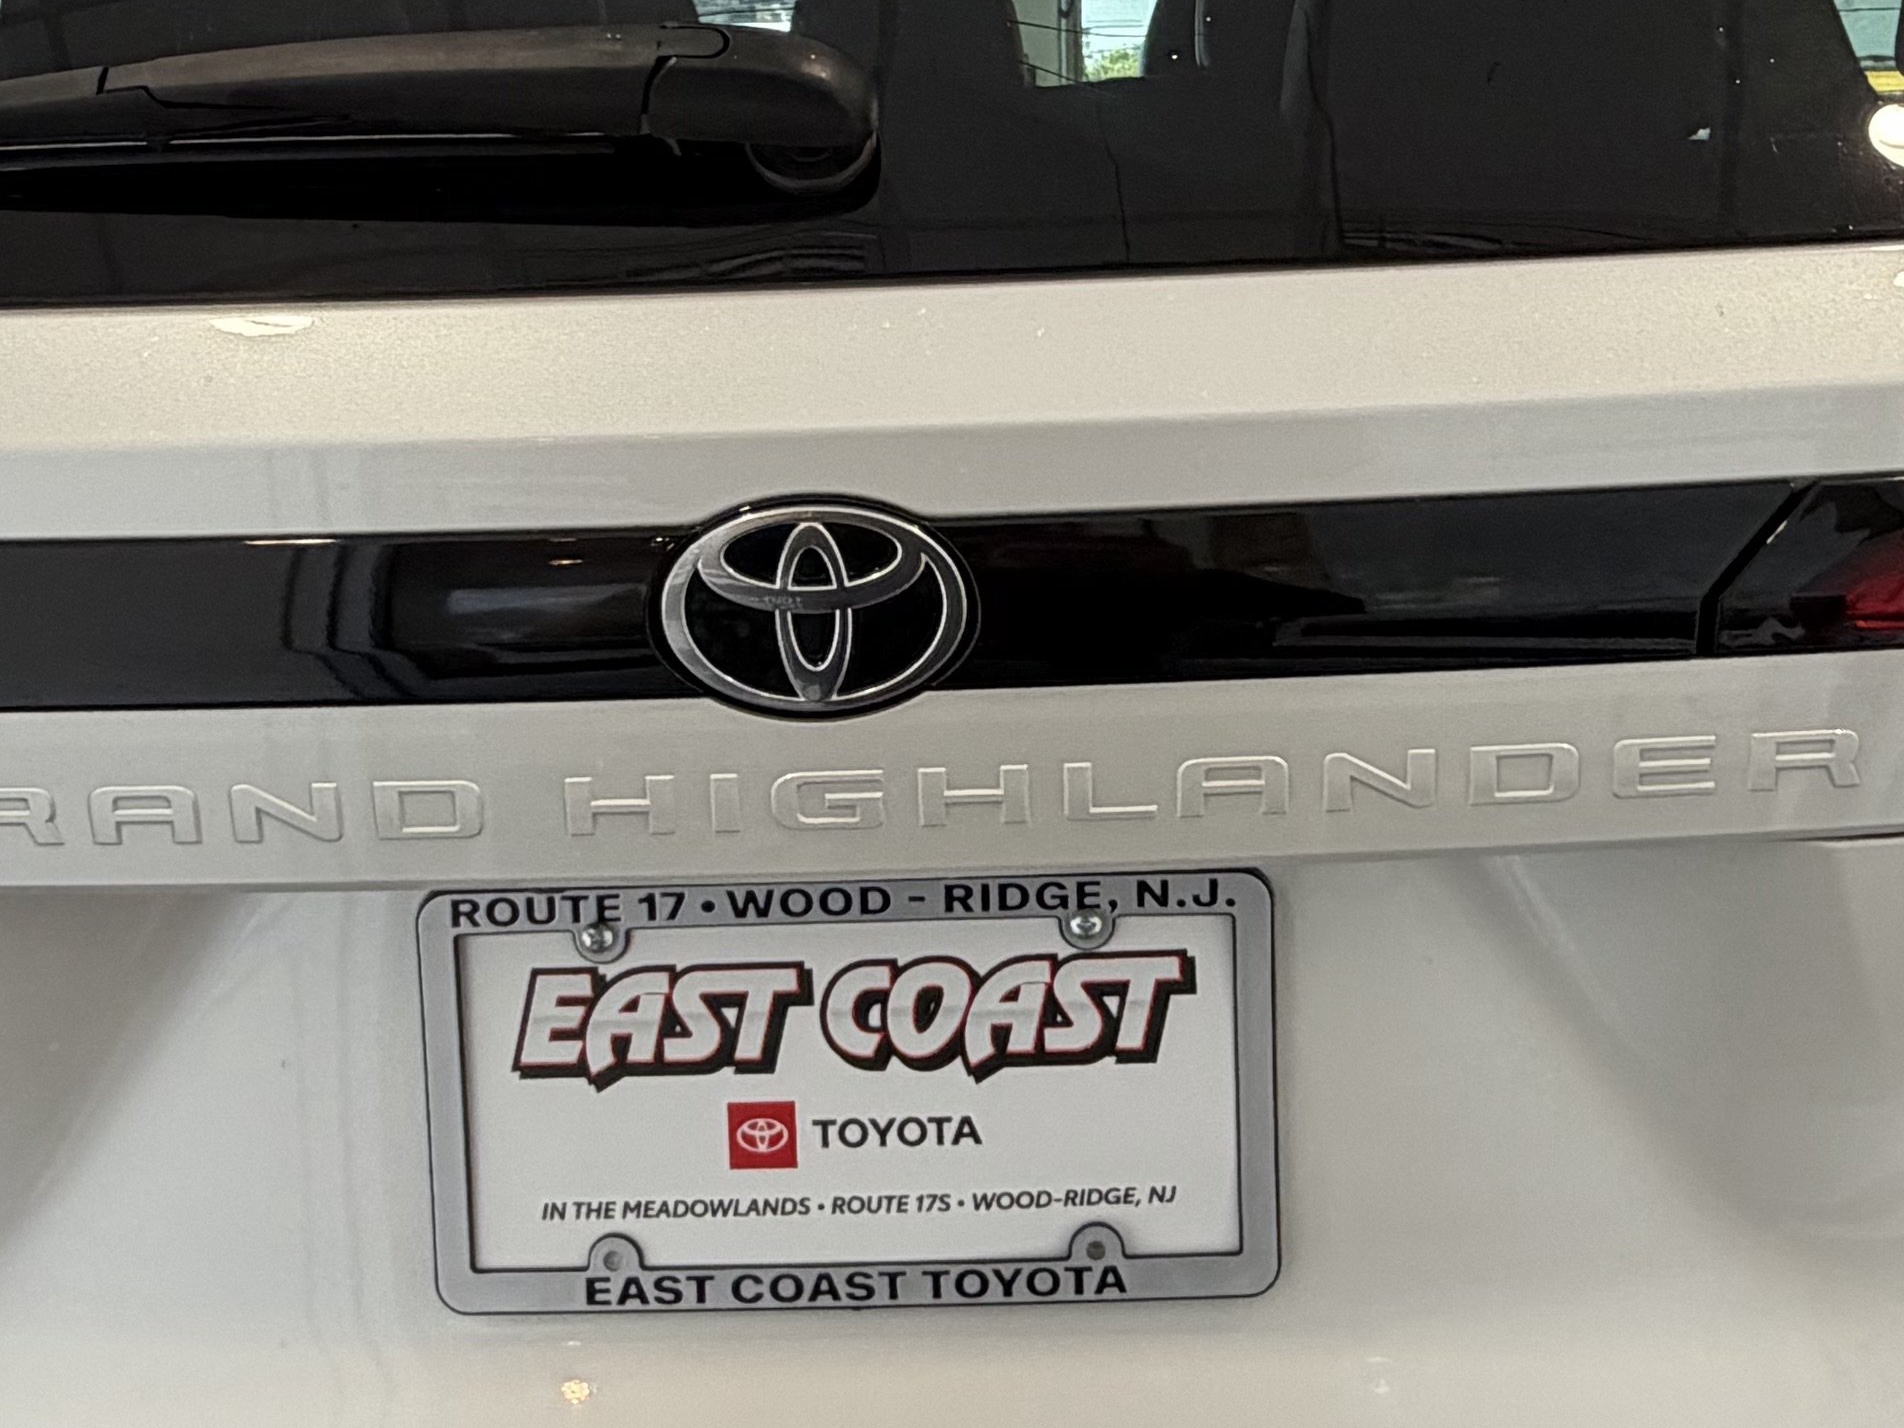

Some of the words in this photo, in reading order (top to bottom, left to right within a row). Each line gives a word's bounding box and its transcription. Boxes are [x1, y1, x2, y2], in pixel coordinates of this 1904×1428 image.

[561, 728, 1862, 836] HIGHLANDER
[450, 893, 623, 928] ROUTE
[638, 891, 687, 922] 17
[725, 885, 892, 919] WOOD
[943, 880, 1118, 914] RIDGE,
[1136, 878, 1237, 909] N.J.
[511, 960, 814, 1093] EAST
[819, 948, 1197, 1085] COAST
[811, 1115, 984, 1149] TOYOTA
[541, 1201, 567, 1221] IN
[573, 1200, 616, 1220] THE
[621, 1196, 812, 1220] MEADOWLANDS
[831, 1194, 910, 1215] ROUTE
[915, 1193, 951, 1213] 17S
[972, 1186, 1142, 1212] WOOD-RIDGE,
[1147, 1185, 1177, 1204] NJ
[584, 1274, 715, 1307] EAST
[730, 1271, 907, 1305] COAST
[921, 1265, 1128, 1300] TOYOTA
